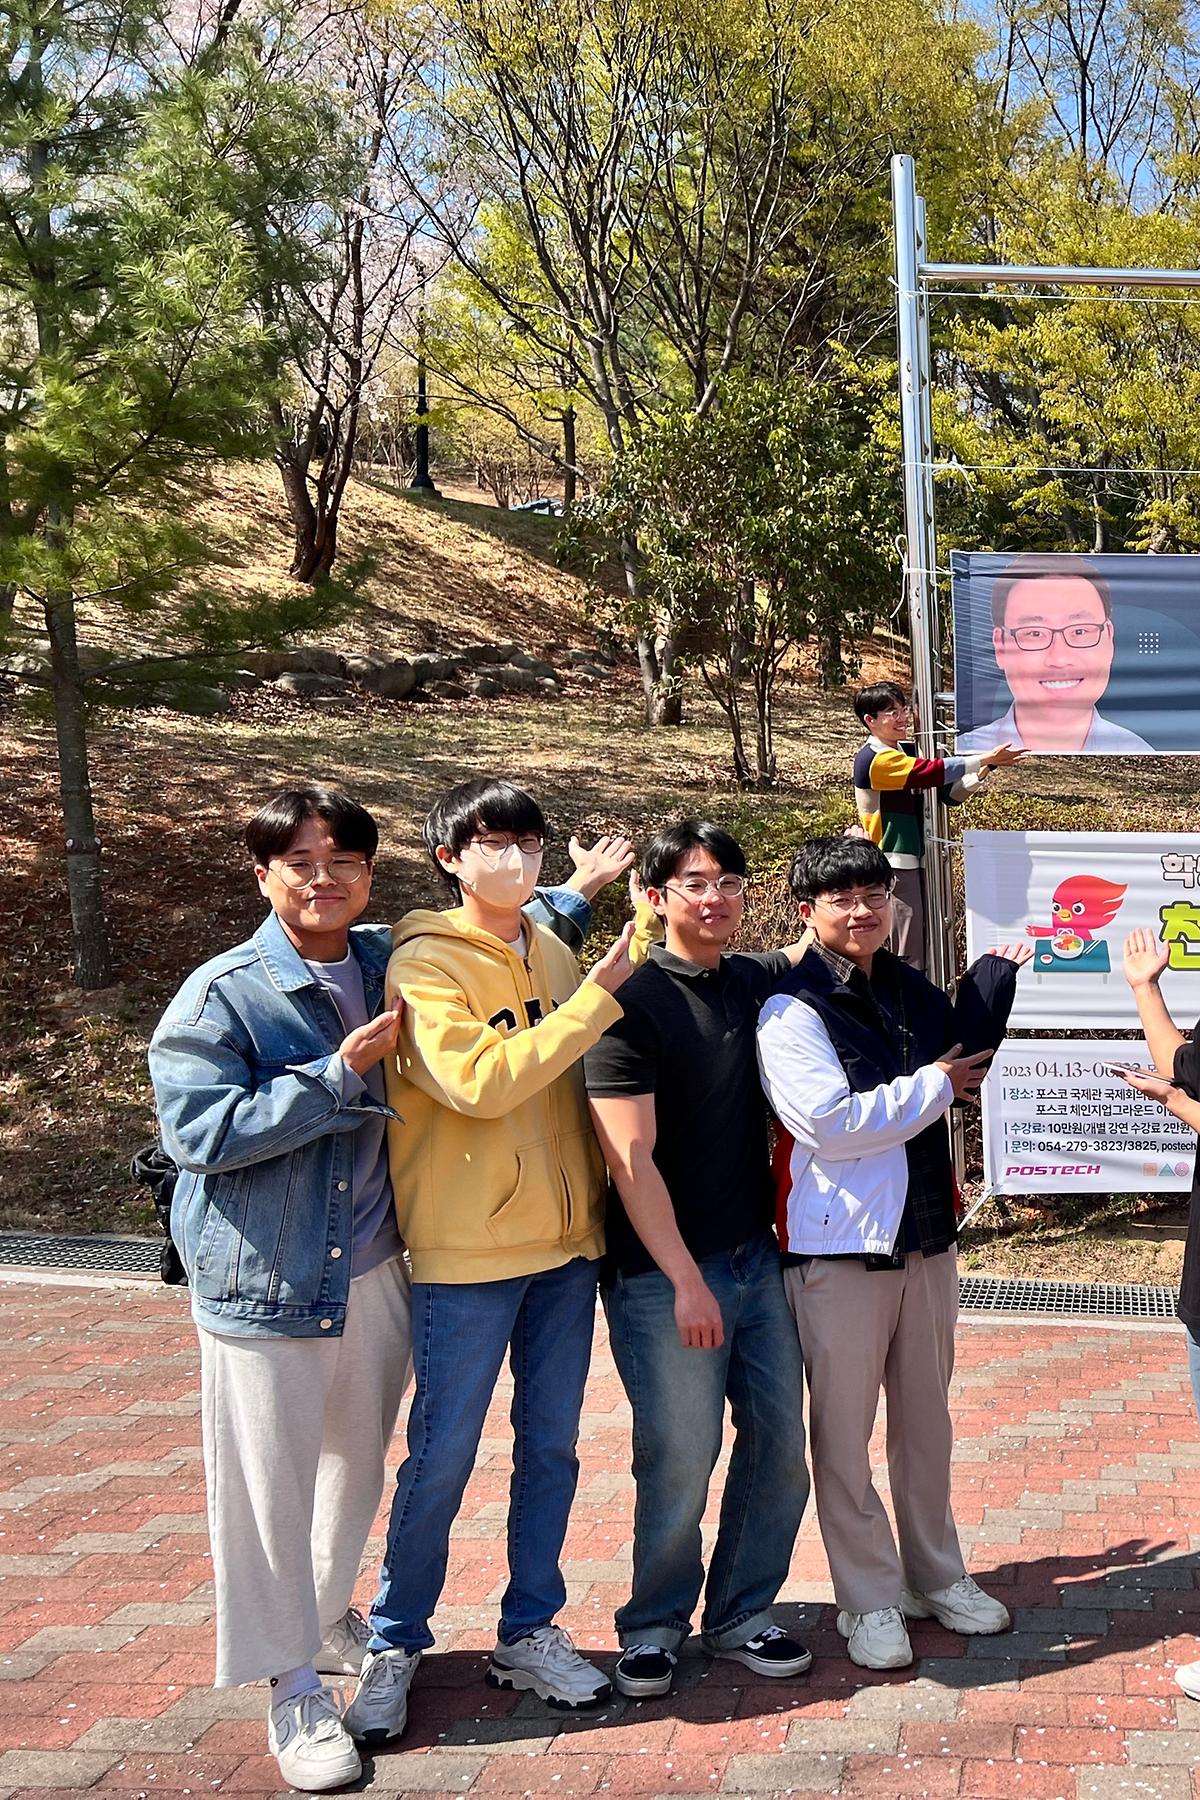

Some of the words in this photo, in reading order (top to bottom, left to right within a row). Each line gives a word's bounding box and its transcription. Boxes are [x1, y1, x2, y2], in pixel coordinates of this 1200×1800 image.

[1002, 1066, 1031, 1077] 2023
[1009, 1088, 1034, 1100] 장소:
[1036, 1089, 1068, 1100] 포스코
[1070, 1088, 1102, 1100] 국제관
[1036, 1105, 1068, 1116] 포스코
[1070, 1104, 1154, 1116] 체인지업그라운드
[1011, 1123, 1046, 1135] 수강료:
[1049, 1122, 1108, 1136] 10만원(개별
[1109, 1123, 1129, 1135] 강연
[1131, 1123, 1161, 1135] 수강료
[1010, 1141, 1036, 1153] 문의:
[1038, 1140, 1160, 1153] 054-279-3823/3825,
